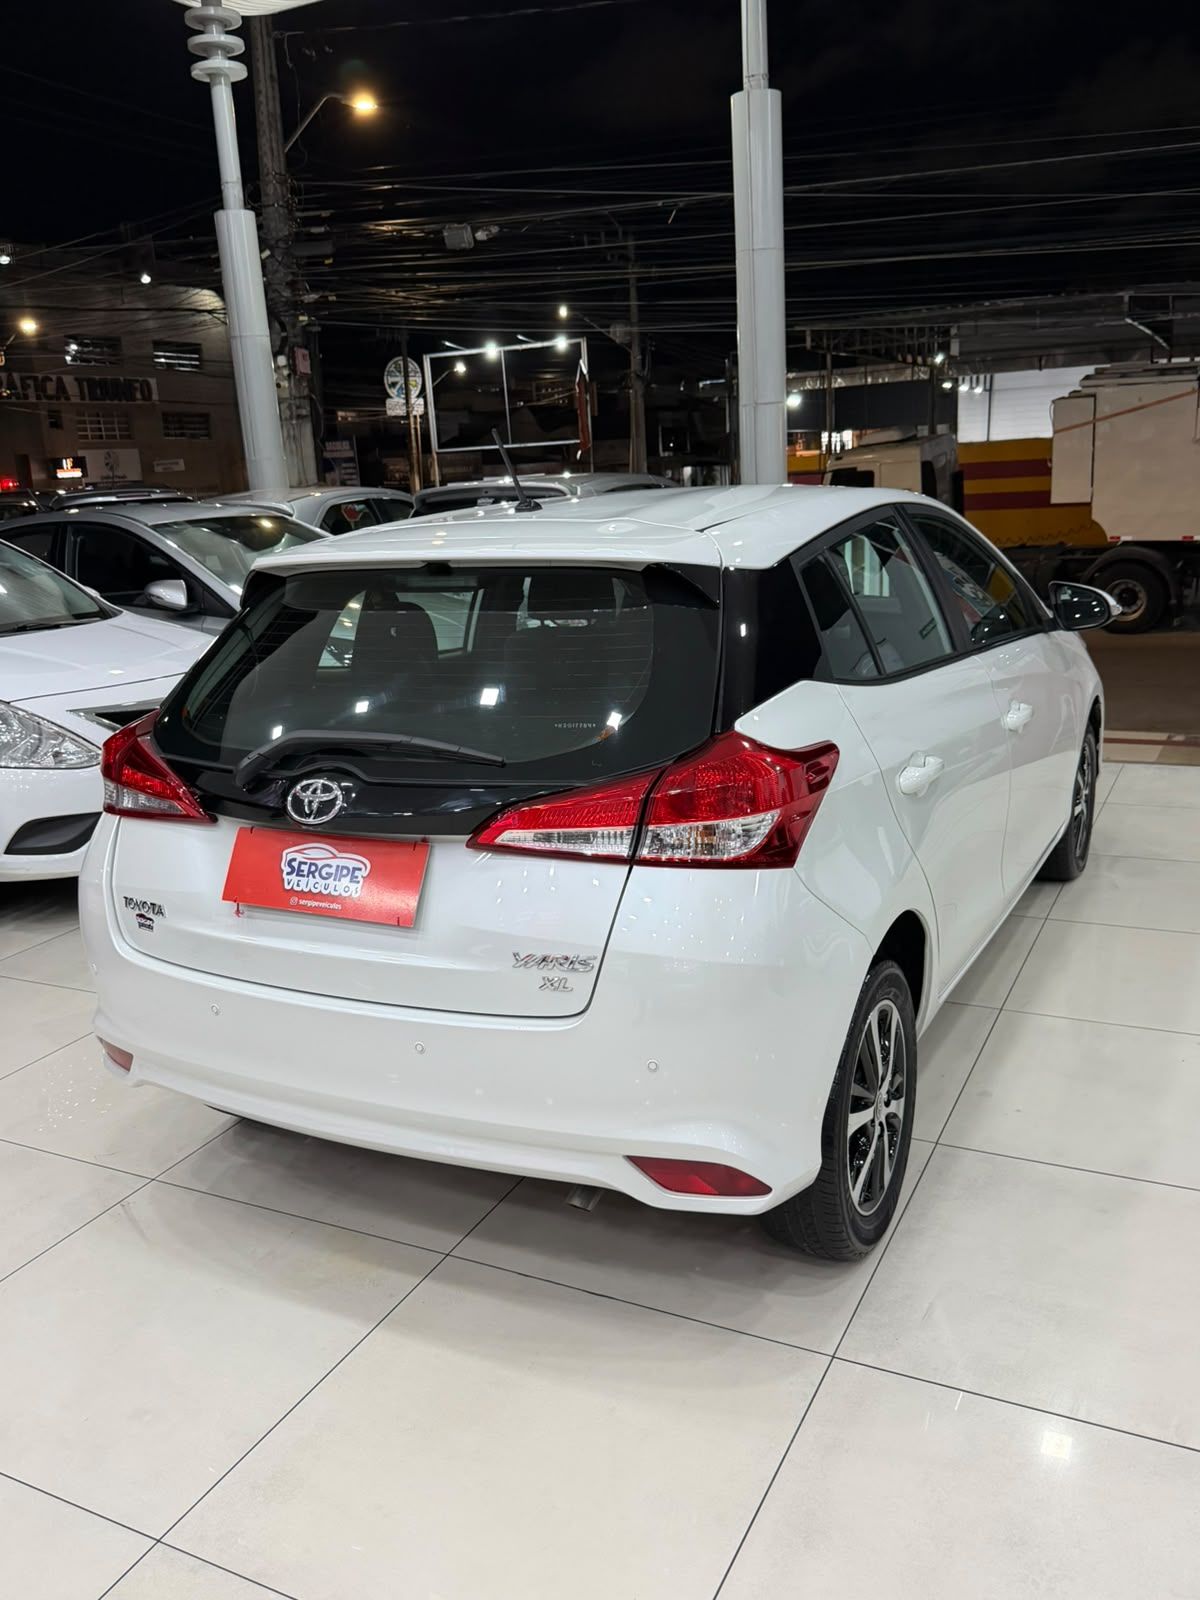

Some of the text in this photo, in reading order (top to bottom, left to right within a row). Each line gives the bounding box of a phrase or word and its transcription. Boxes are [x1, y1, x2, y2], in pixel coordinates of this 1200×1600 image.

[286, 857, 363, 884] SERGIPE
[123, 896, 165, 917] TOYOTA
[512, 952, 598, 973] YARIS
[538, 976, 574, 992] XL
